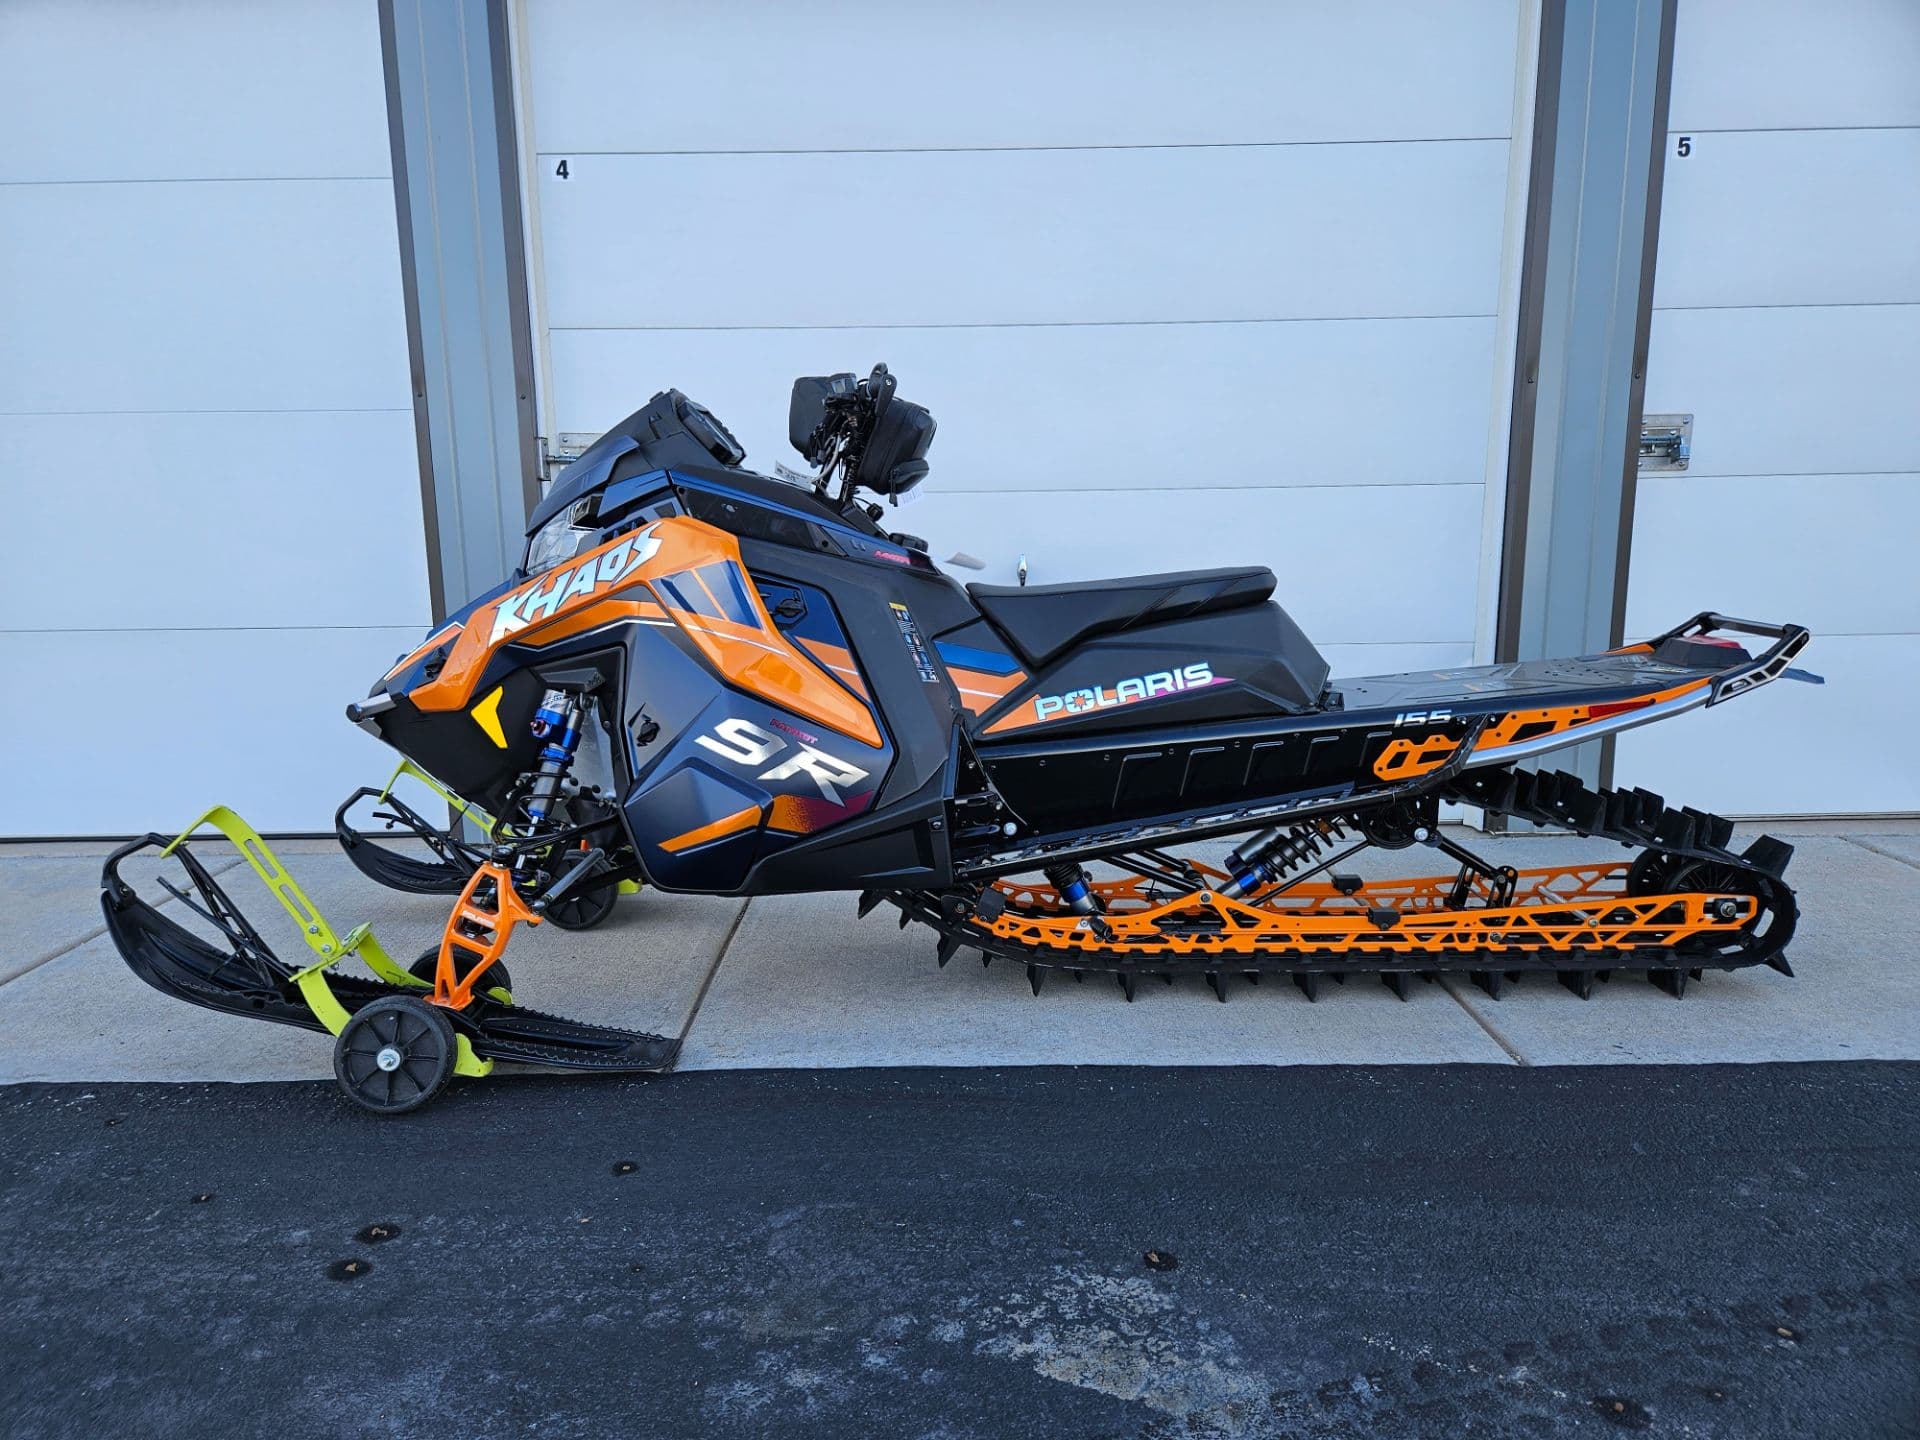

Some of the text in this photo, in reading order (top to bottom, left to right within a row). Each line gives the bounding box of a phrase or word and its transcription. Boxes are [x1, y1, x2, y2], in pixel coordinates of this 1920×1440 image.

[1677, 136, 1691, 157] 5
[556, 159, 570, 180] 4
[487, 521, 664, 648] KHAOS
[1034, 662, 1214, 721] POLARIS
[1394, 709, 1452, 728] 155
